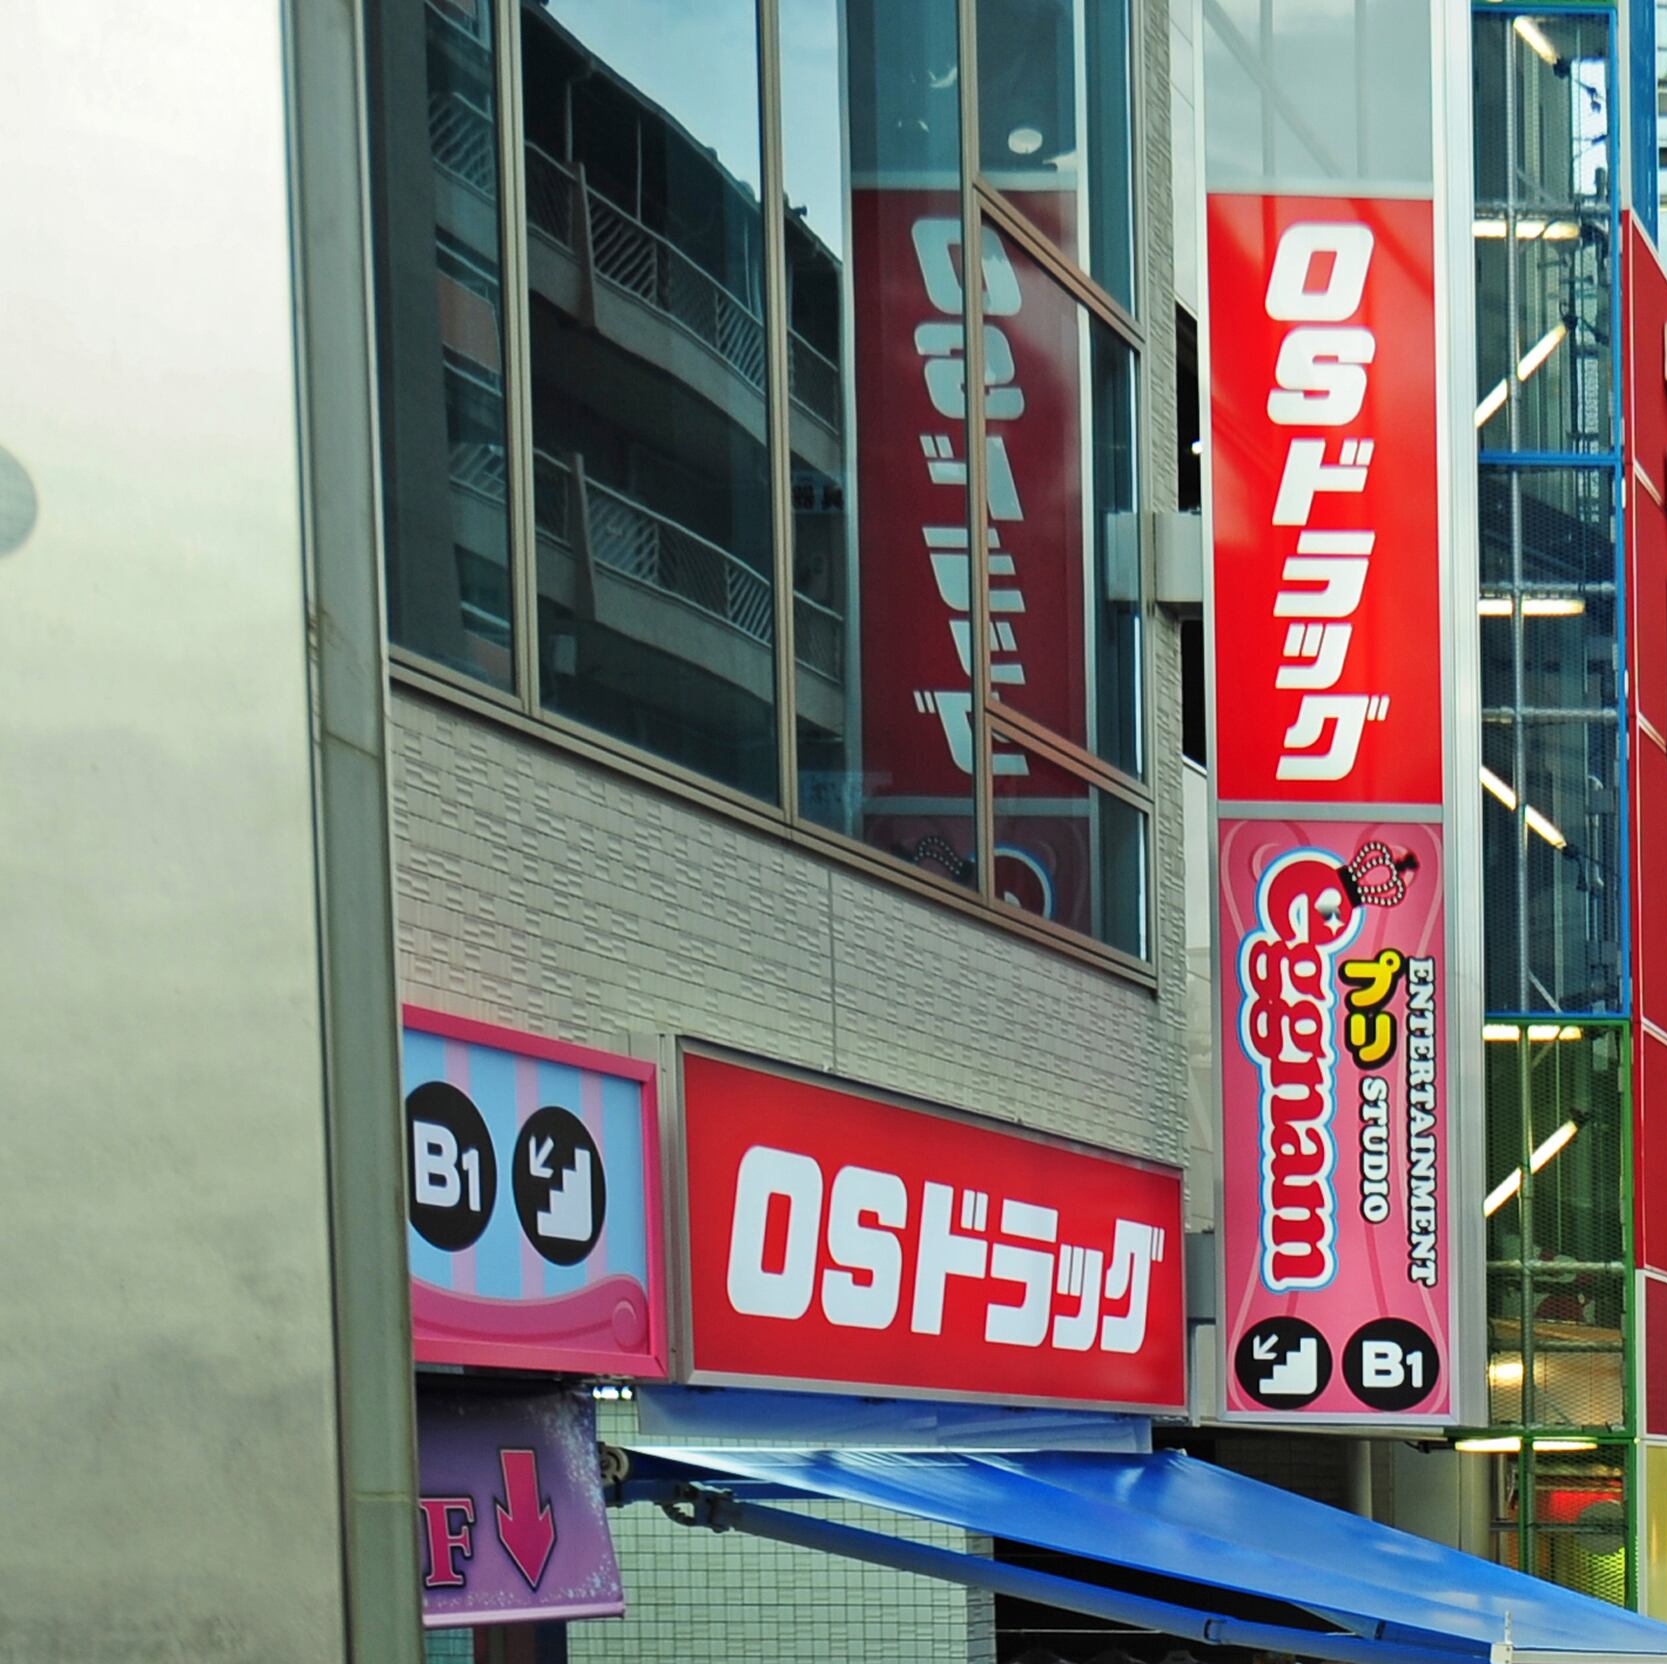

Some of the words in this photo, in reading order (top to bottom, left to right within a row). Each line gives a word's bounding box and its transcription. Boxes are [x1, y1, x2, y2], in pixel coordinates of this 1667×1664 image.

[1262, 220, 1377, 782] OSドラッグ
[411, 1119, 482, 1213] B1
[1360, 1076, 1391, 1224] STUDIO
[1406, 956, 1439, 1287] ENTERTAINMENT
[726, 1144, 1165, 1356] OSドラッグ
[1361, 1347, 1423, 1388] B1
